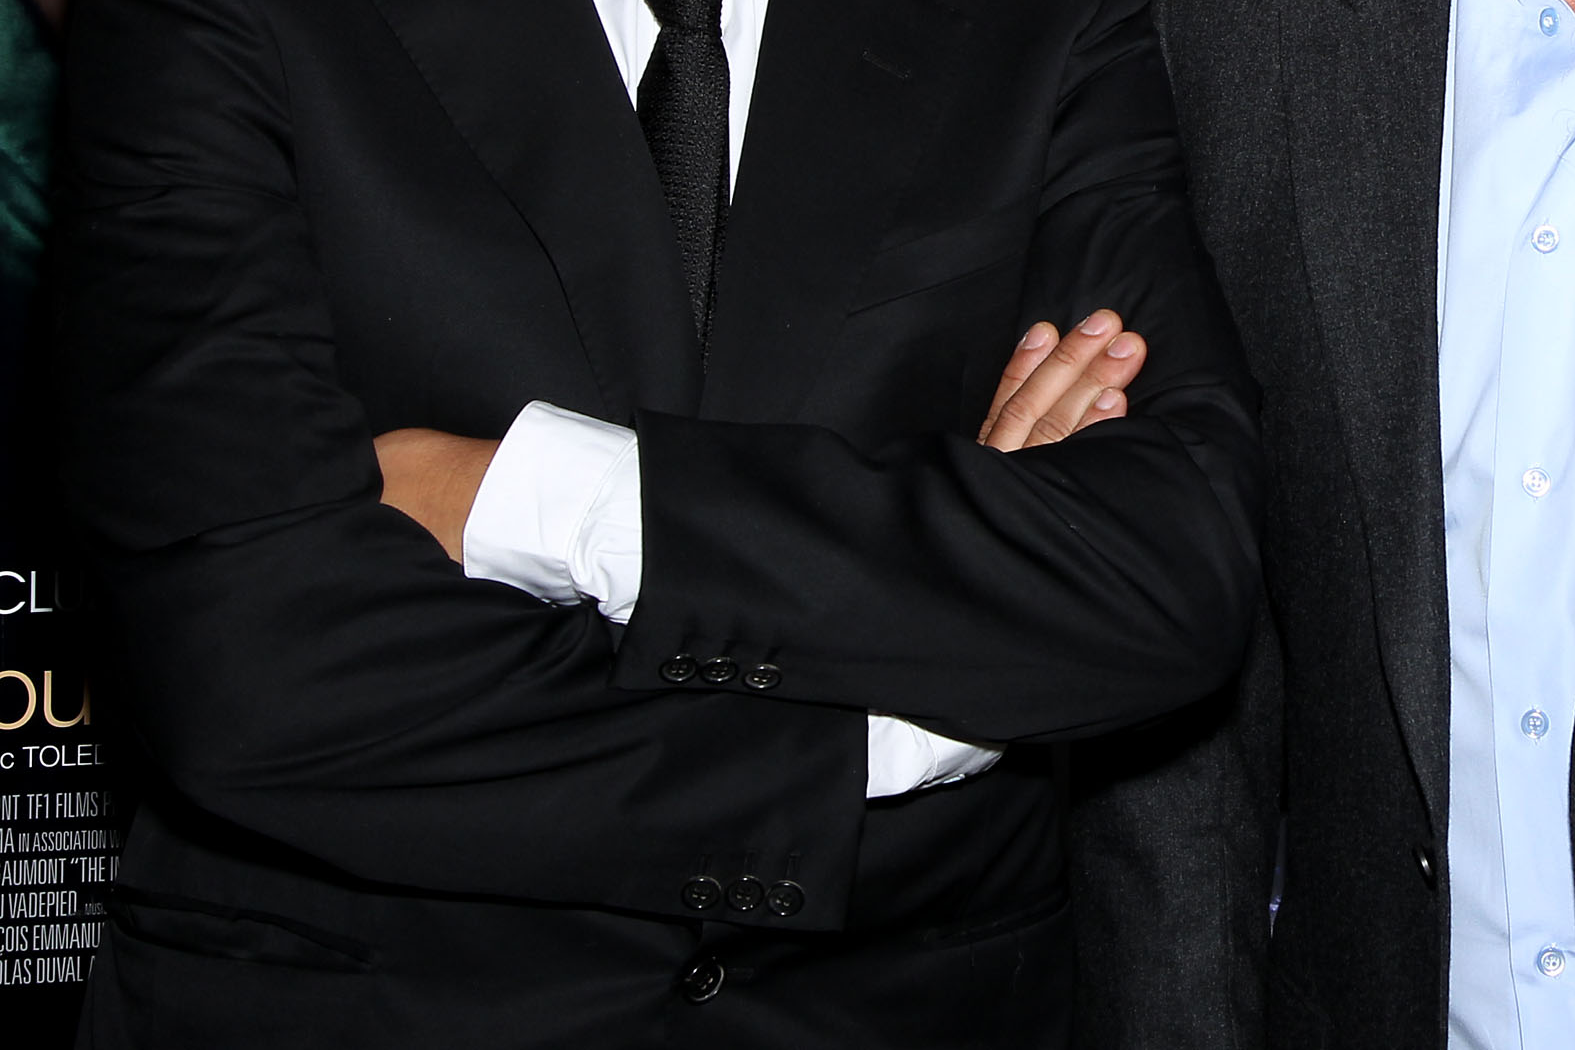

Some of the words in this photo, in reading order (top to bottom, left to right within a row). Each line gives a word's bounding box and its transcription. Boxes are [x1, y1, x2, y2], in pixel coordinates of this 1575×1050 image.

[26, 793, 50, 820] TF1
[55, 791, 99, 819] FILMS
[18, 833, 30, 853] IN
[32, 829, 107, 853] ASSOCIATION
[0, 858, 67, 887] AUMONT
[8, 890, 78, 919] VADEPIED
[32, 922, 104, 951] EMMANU
[0, 958, 32, 986] LAS
[36, 955, 84, 984] DUVAL
